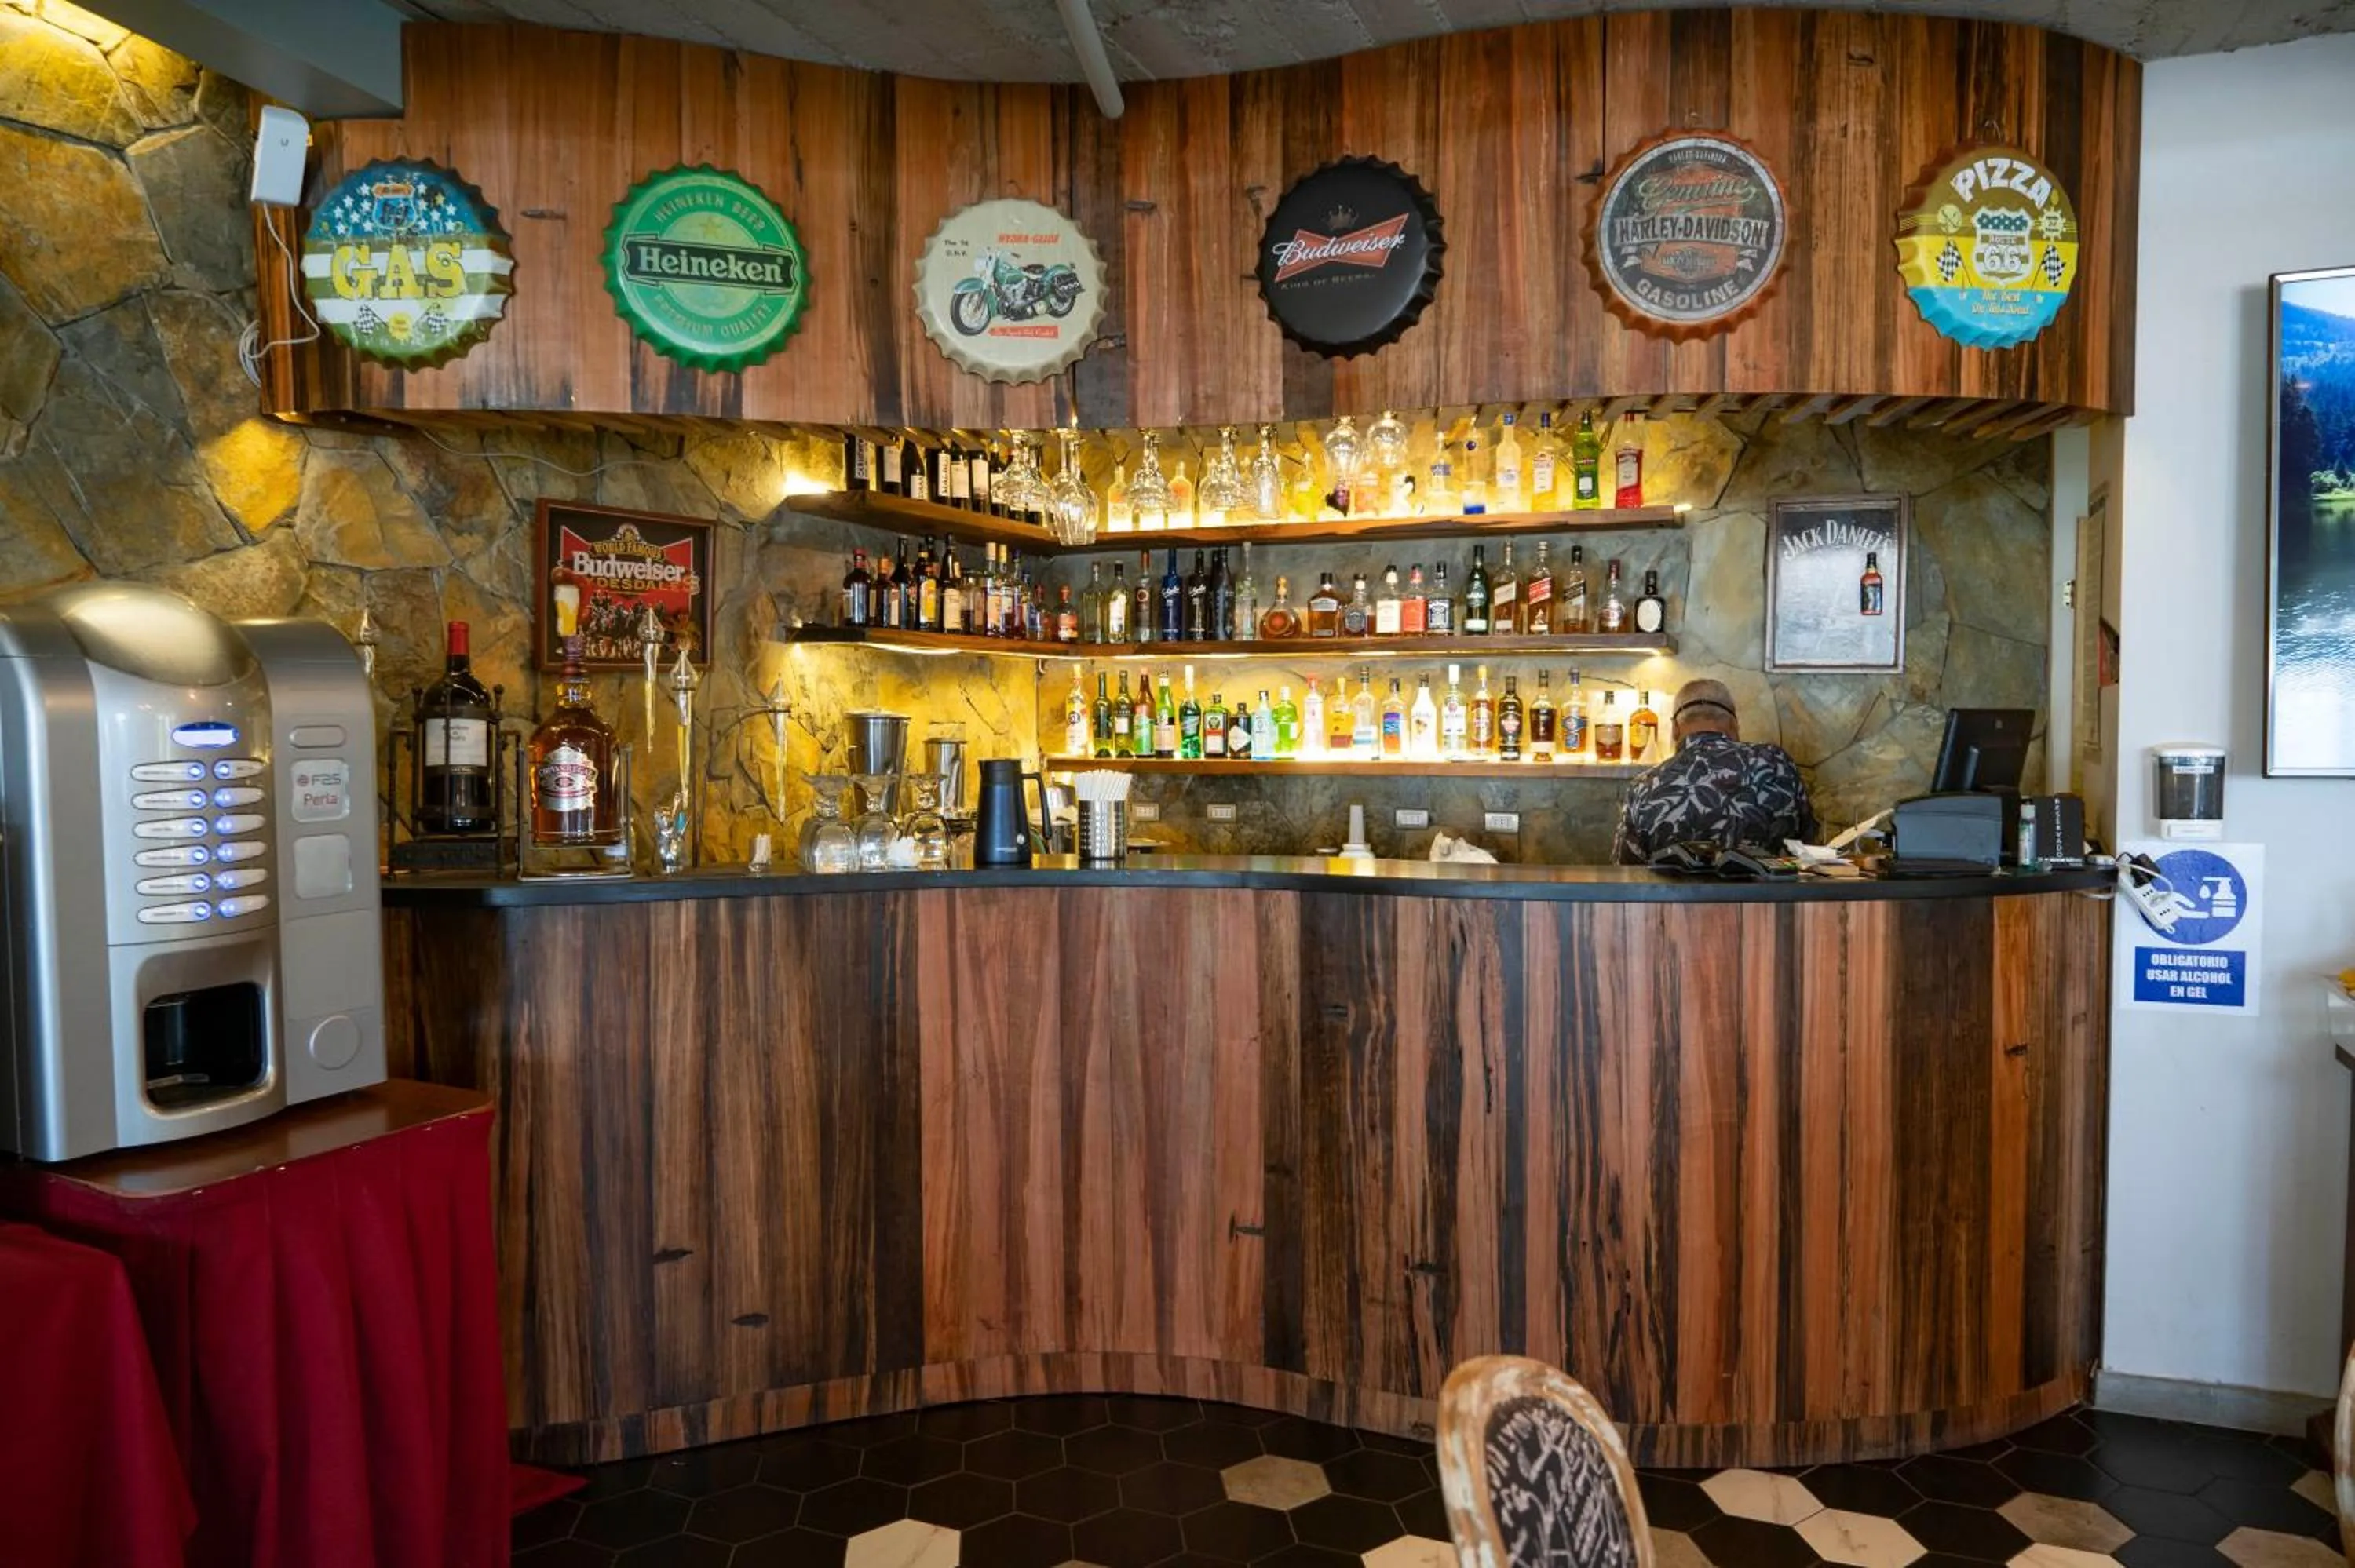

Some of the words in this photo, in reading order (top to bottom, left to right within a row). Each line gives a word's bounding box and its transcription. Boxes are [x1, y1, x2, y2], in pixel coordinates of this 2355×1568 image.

[1951, 158, 2052, 210] PIZZA
[654, 193, 724, 223] HEINEKEN
[732, 200, 766, 232] BEER
[1619, 217, 1765, 246] HARLEY-DAVIDSON
[638, 246, 783, 283] Heineken
[1272, 233, 1406, 267] Budweiser
[1984, 245, 2022, 272] 66
[331, 242, 468, 301] GAS
[1636, 279, 1740, 308] GASOLINE
[593, 541, 626, 554] WORLD
[629, 542, 665, 562] FAMOUS
[1783, 527, 1824, 561] JACK
[572, 551, 686, 583] Budweiser
[304, 793, 338, 806] Perla
[2151, 954, 2229, 968] OBLIGATORIO
[2146, 969, 2178, 982] USAR
[2180, 970, 2233, 984] ALCOHOL
[2169, 985, 2185, 997] EN
[2186, 986, 2207, 999] GEL
